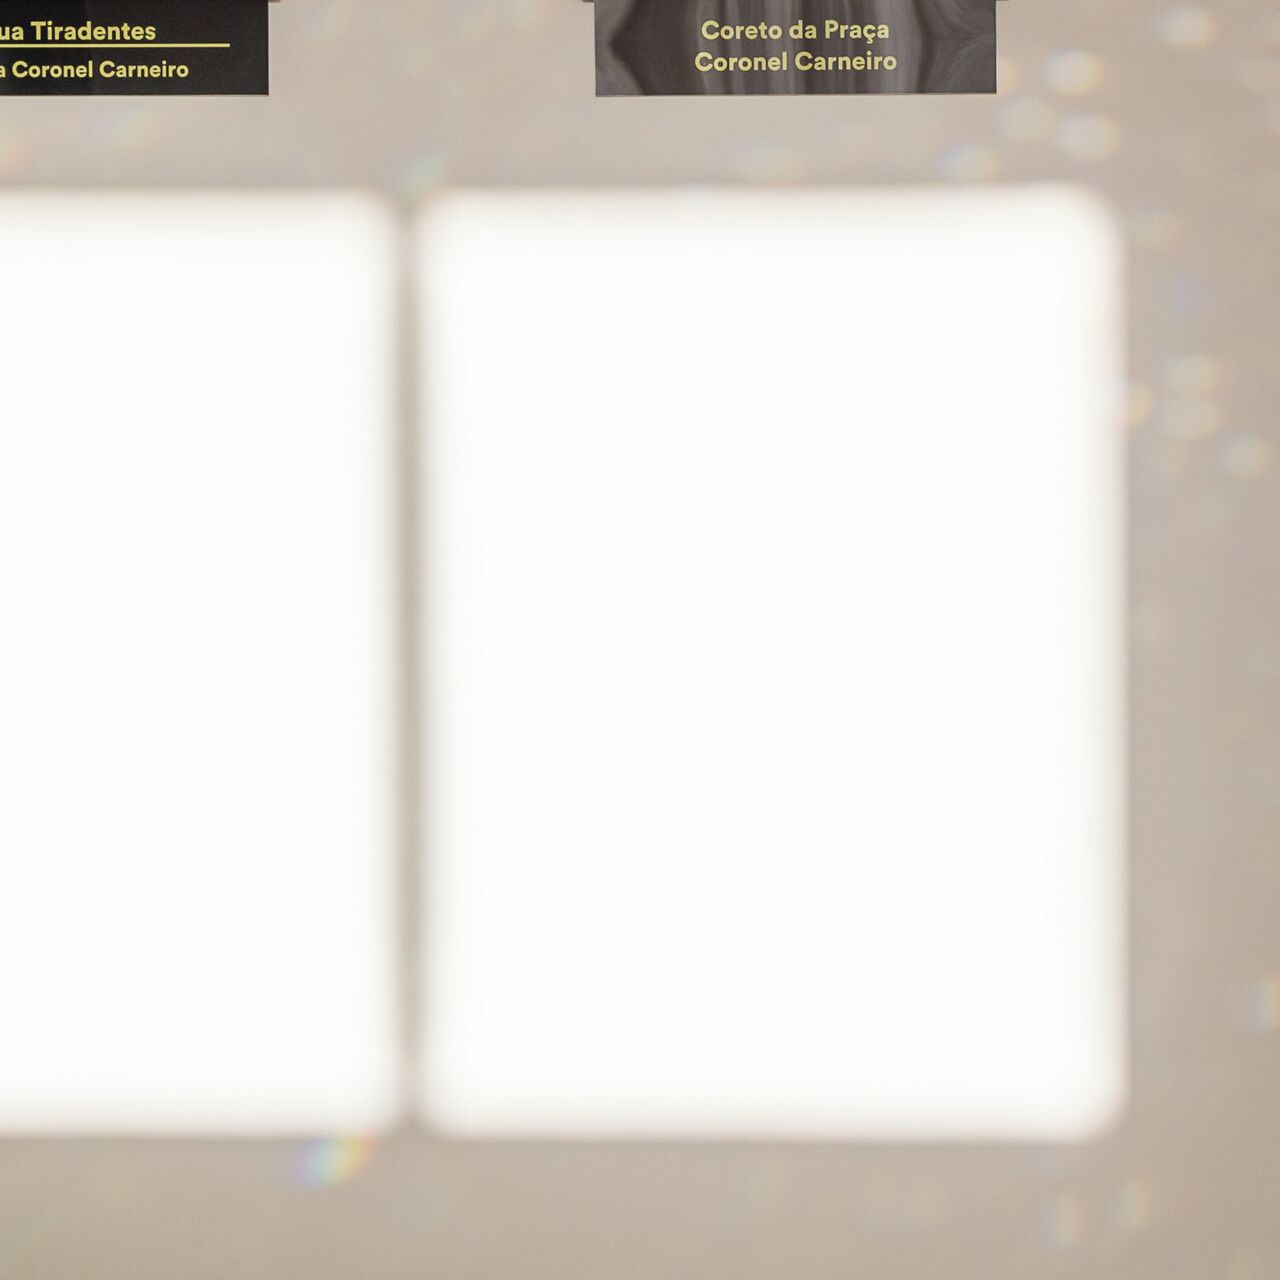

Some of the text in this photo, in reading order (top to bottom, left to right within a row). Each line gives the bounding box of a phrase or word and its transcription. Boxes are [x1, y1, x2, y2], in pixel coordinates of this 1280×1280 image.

[30, 20, 157, 41] Tiradentes
[700, 19, 890, 45] Coreto da Praça
[11, 60, 94, 79] Coronel
[98, 60, 189, 79] Carneiro
[694, 50, 897, 72] Coronel Carneiro
